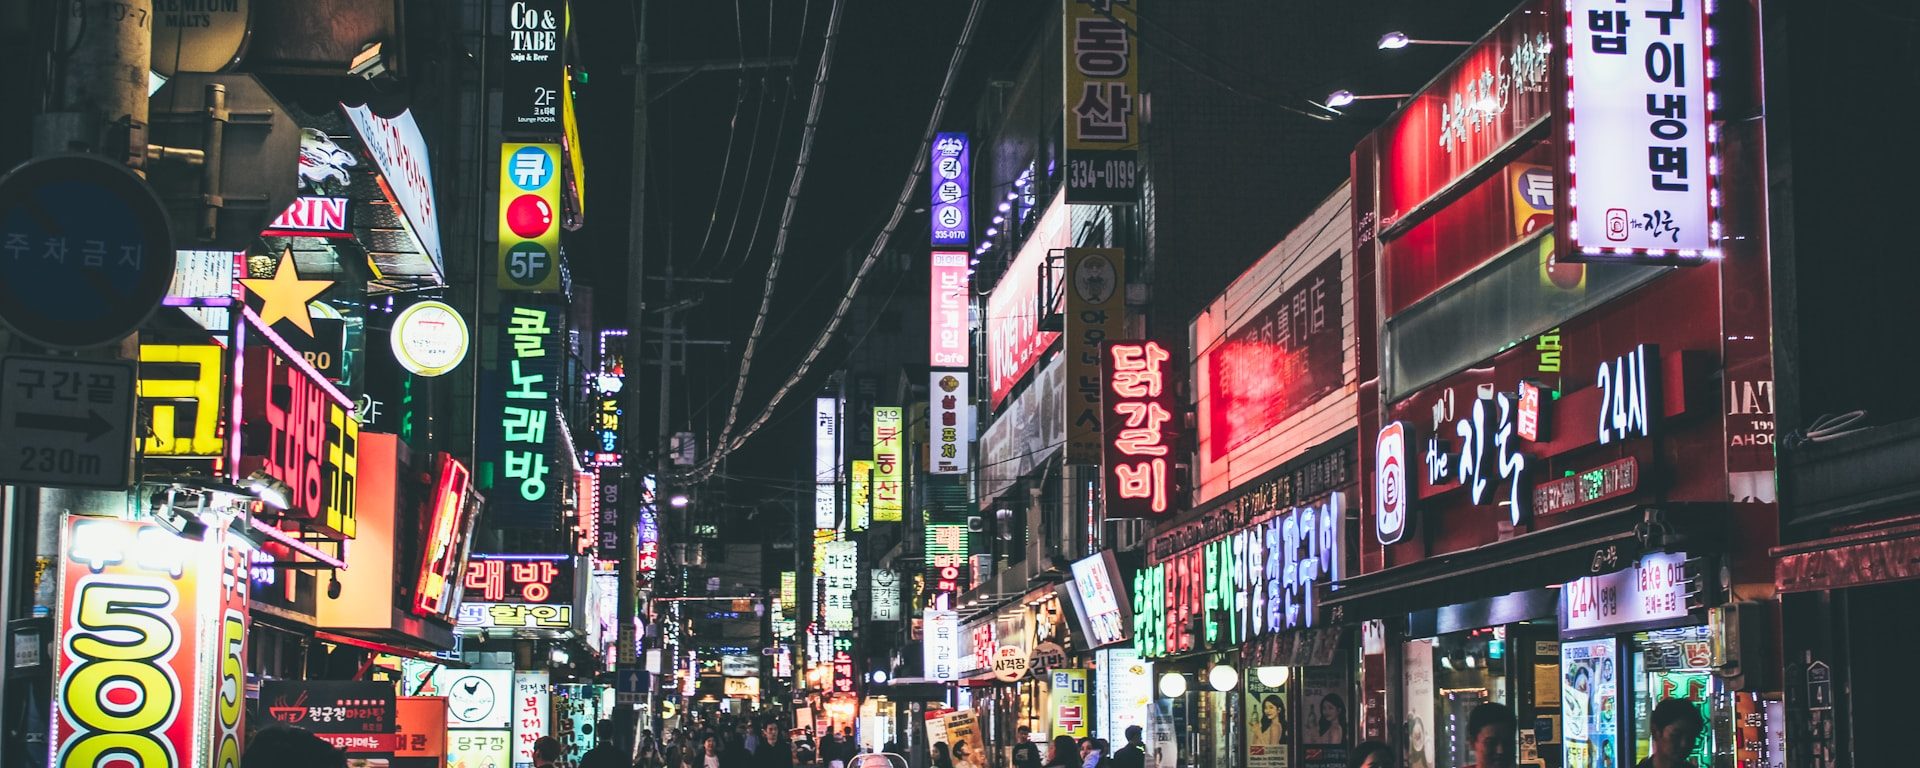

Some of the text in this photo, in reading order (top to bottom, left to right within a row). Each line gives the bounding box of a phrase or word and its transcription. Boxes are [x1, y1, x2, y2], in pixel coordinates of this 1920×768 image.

[150, 0, 238, 12] REMIUM
[165, 14, 210, 28] MALTS
[511, 1, 557, 30] Co &
[511, 31, 556, 51] TABE
[1588, 0, 1631, 56] 밥
[511, 53, 525, 62] Soju
[1070, 0, 1132, 144] 동산
[534, 87, 556, 106] 2F
[514, 153, 547, 186] 큐
[1071, 159, 1135, 189] 334-0199
[942, 158, 959, 226] 킥복싱
[270, 198, 348, 228] RIN
[935, 229, 966, 240] 335-0170
[4, 233, 143, 271] 주차금지
[510, 251, 546, 279] 5F
[935, 352, 962, 364] Cafe
[16, 368, 116, 404] 구간끝
[1597, 343, 1648, 445] 24시
[361, 393, 384, 424] 2F
[502, 307, 551, 501] 콜노래방
[877, 410, 899, 422] 연우
[1111, 341, 1172, 513] 닭갈비
[19, 446, 101, 475] 230m
[877, 426, 898, 501] 부동산
[1425, 438, 1448, 485] the
[603, 484, 619, 550] 영화관
[1636, 560, 1661, 592] Take
[1572, 577, 1617, 620] 24시 영업
[995, 658, 1026, 671] 사격장
[520, 683, 548, 694] 의정부
[458, 736, 505, 751] 당구장
